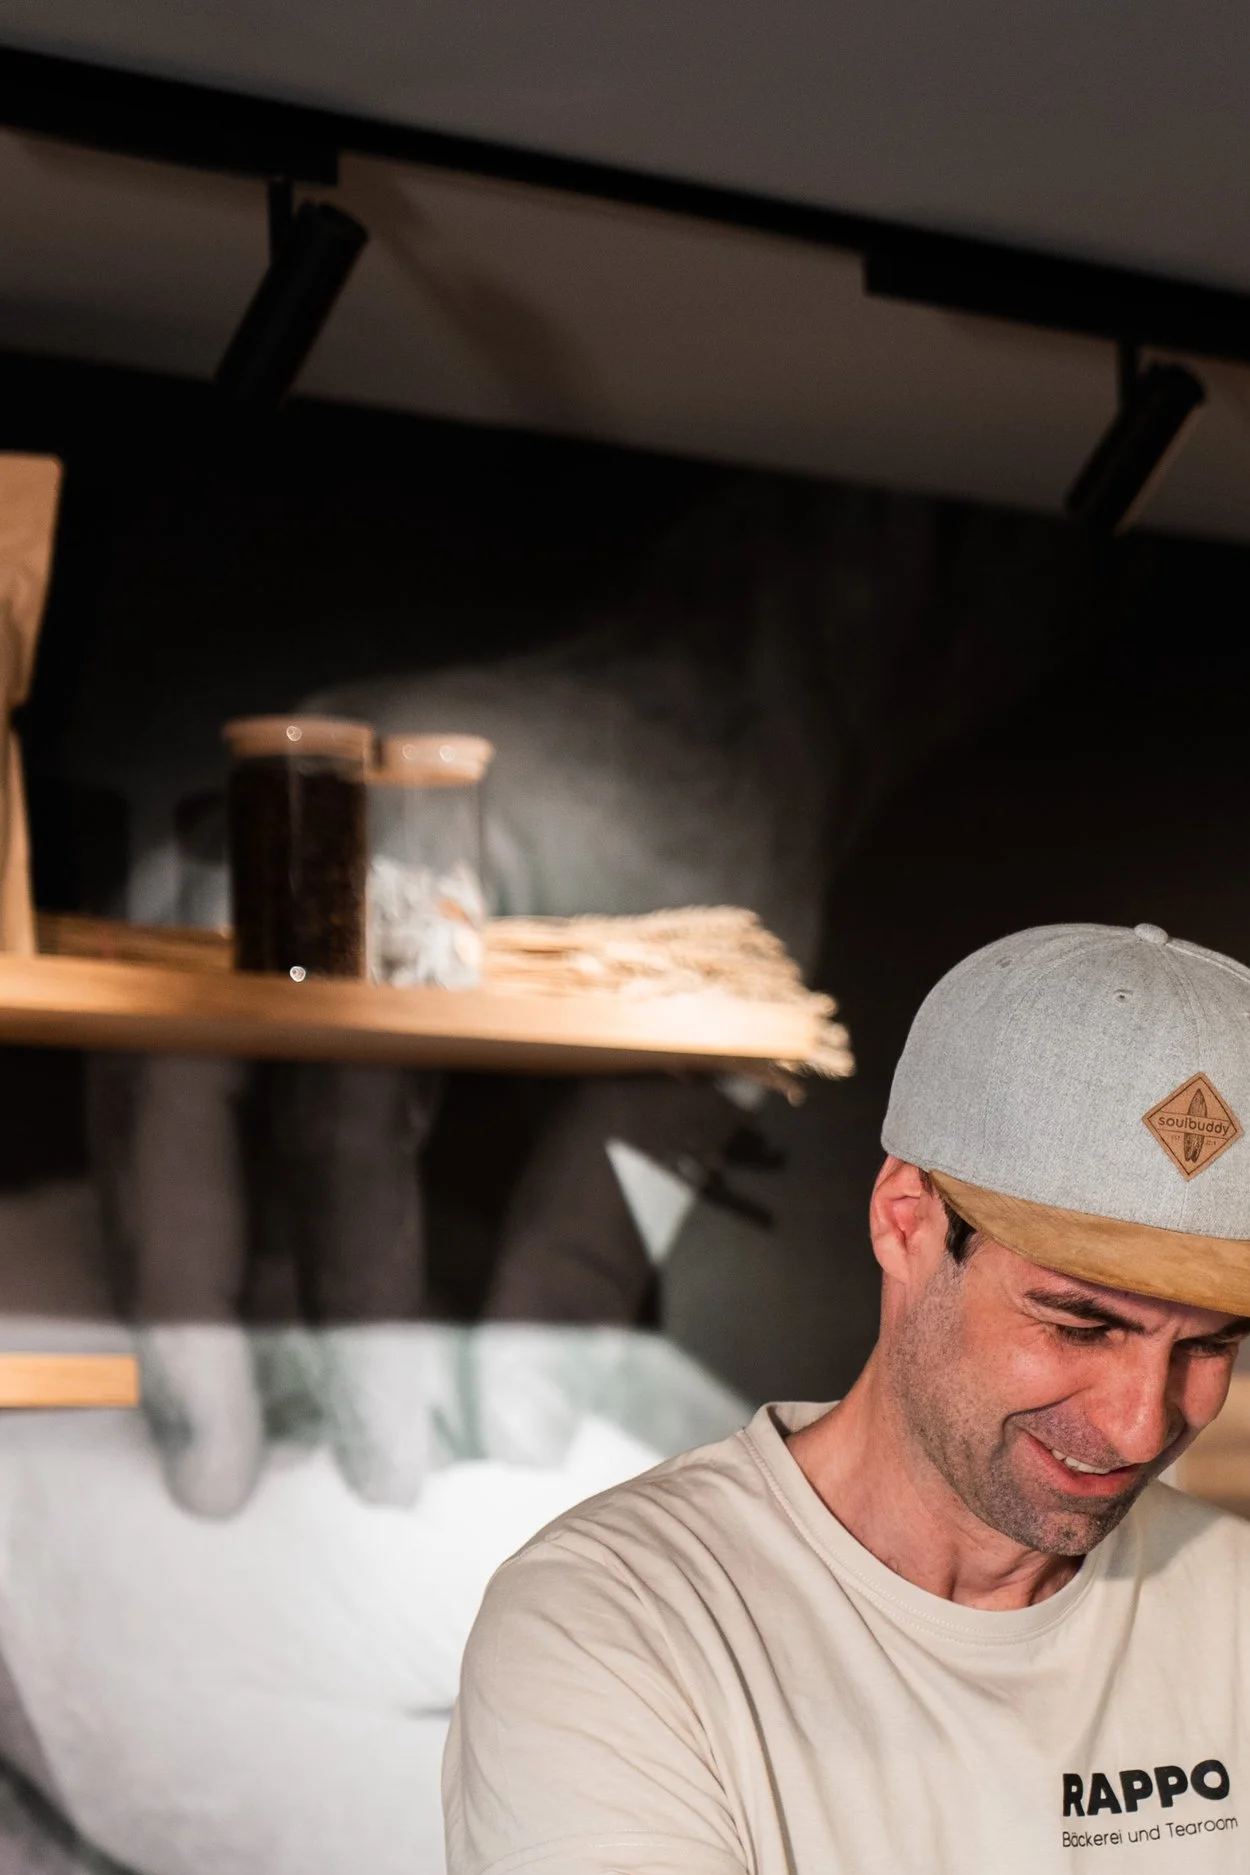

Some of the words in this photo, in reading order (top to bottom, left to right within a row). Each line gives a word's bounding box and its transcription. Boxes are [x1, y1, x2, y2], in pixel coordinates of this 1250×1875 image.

[1158, 1117, 1230, 1137] soulbuddy
[1062, 1758, 1231, 1817] RAPPO
[1062, 1829, 1124, 1849] Bäckerei
[1128, 1825, 1161, 1844] und
[1166, 1816, 1239, 1838] Tearoom
